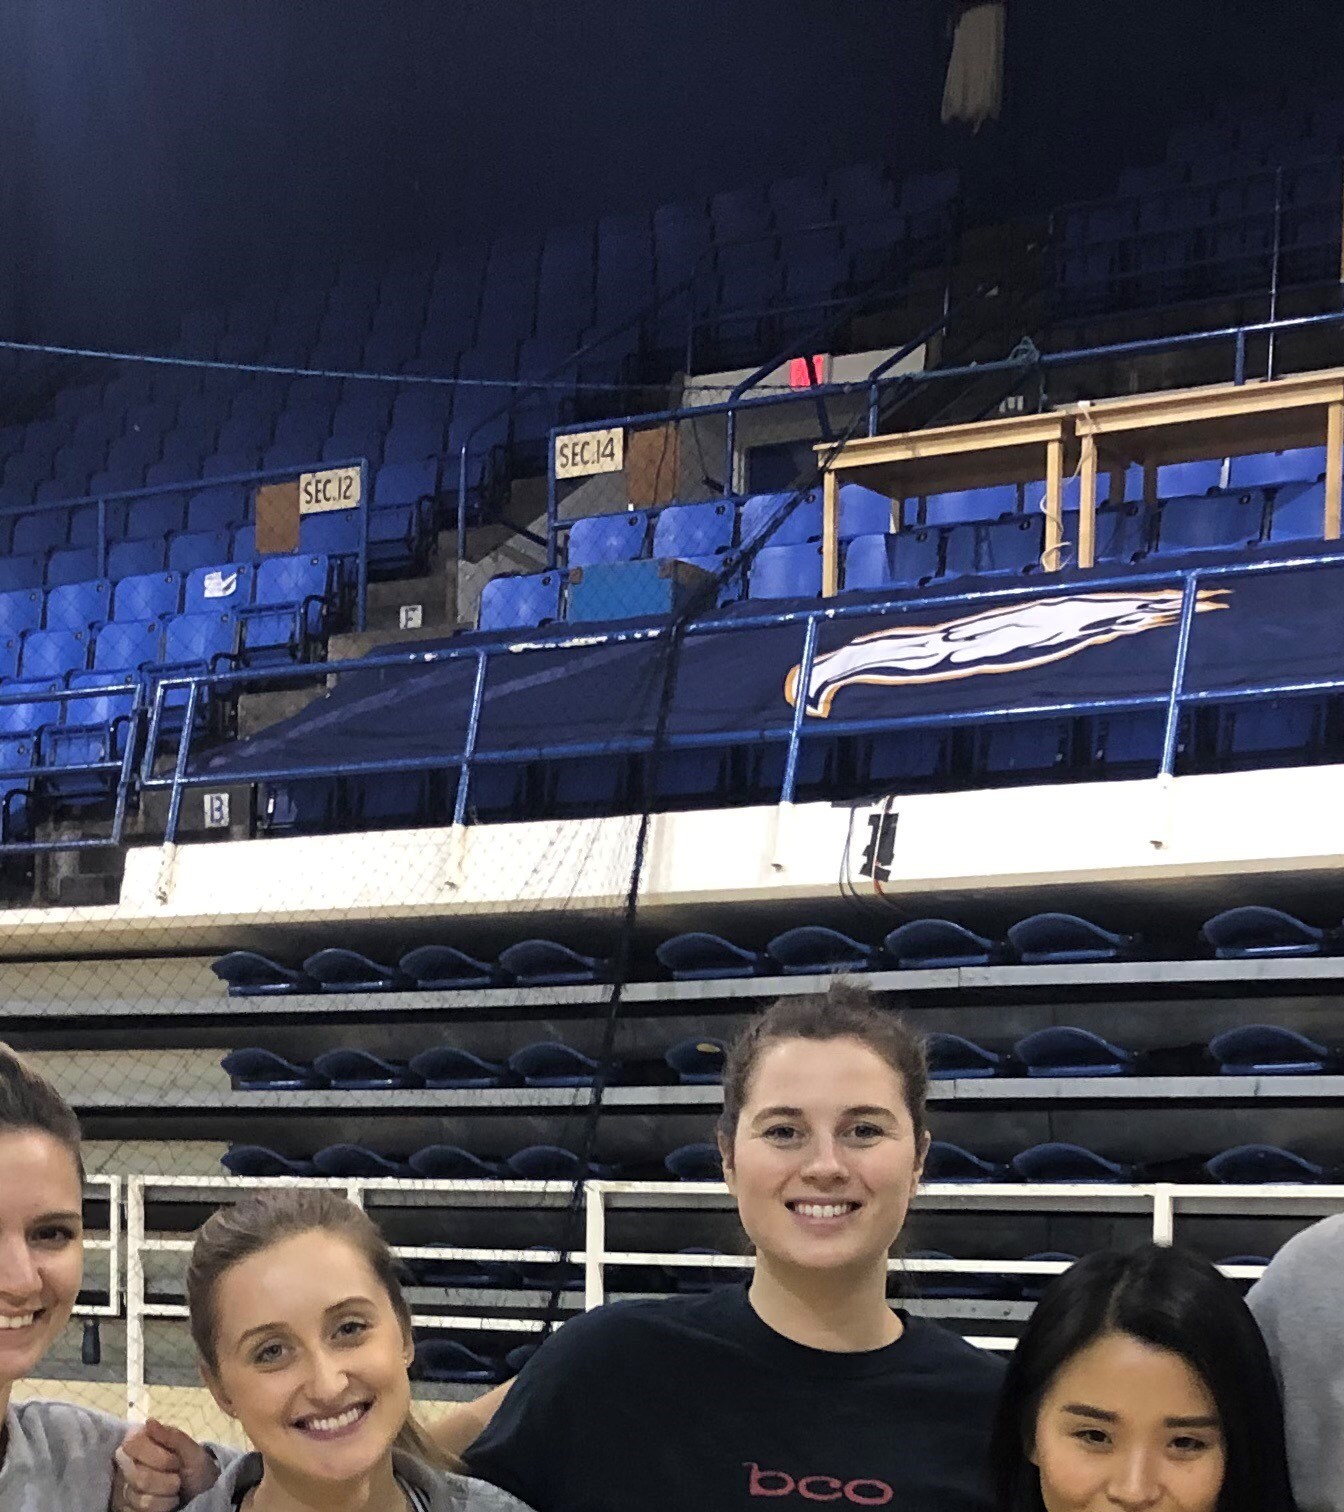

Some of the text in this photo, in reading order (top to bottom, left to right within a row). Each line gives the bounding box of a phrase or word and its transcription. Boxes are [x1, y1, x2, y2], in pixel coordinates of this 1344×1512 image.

[303, 475, 354, 505] SEC.12
[210, 795, 224, 824] B
[742, 1461, 895, 1506] bco
